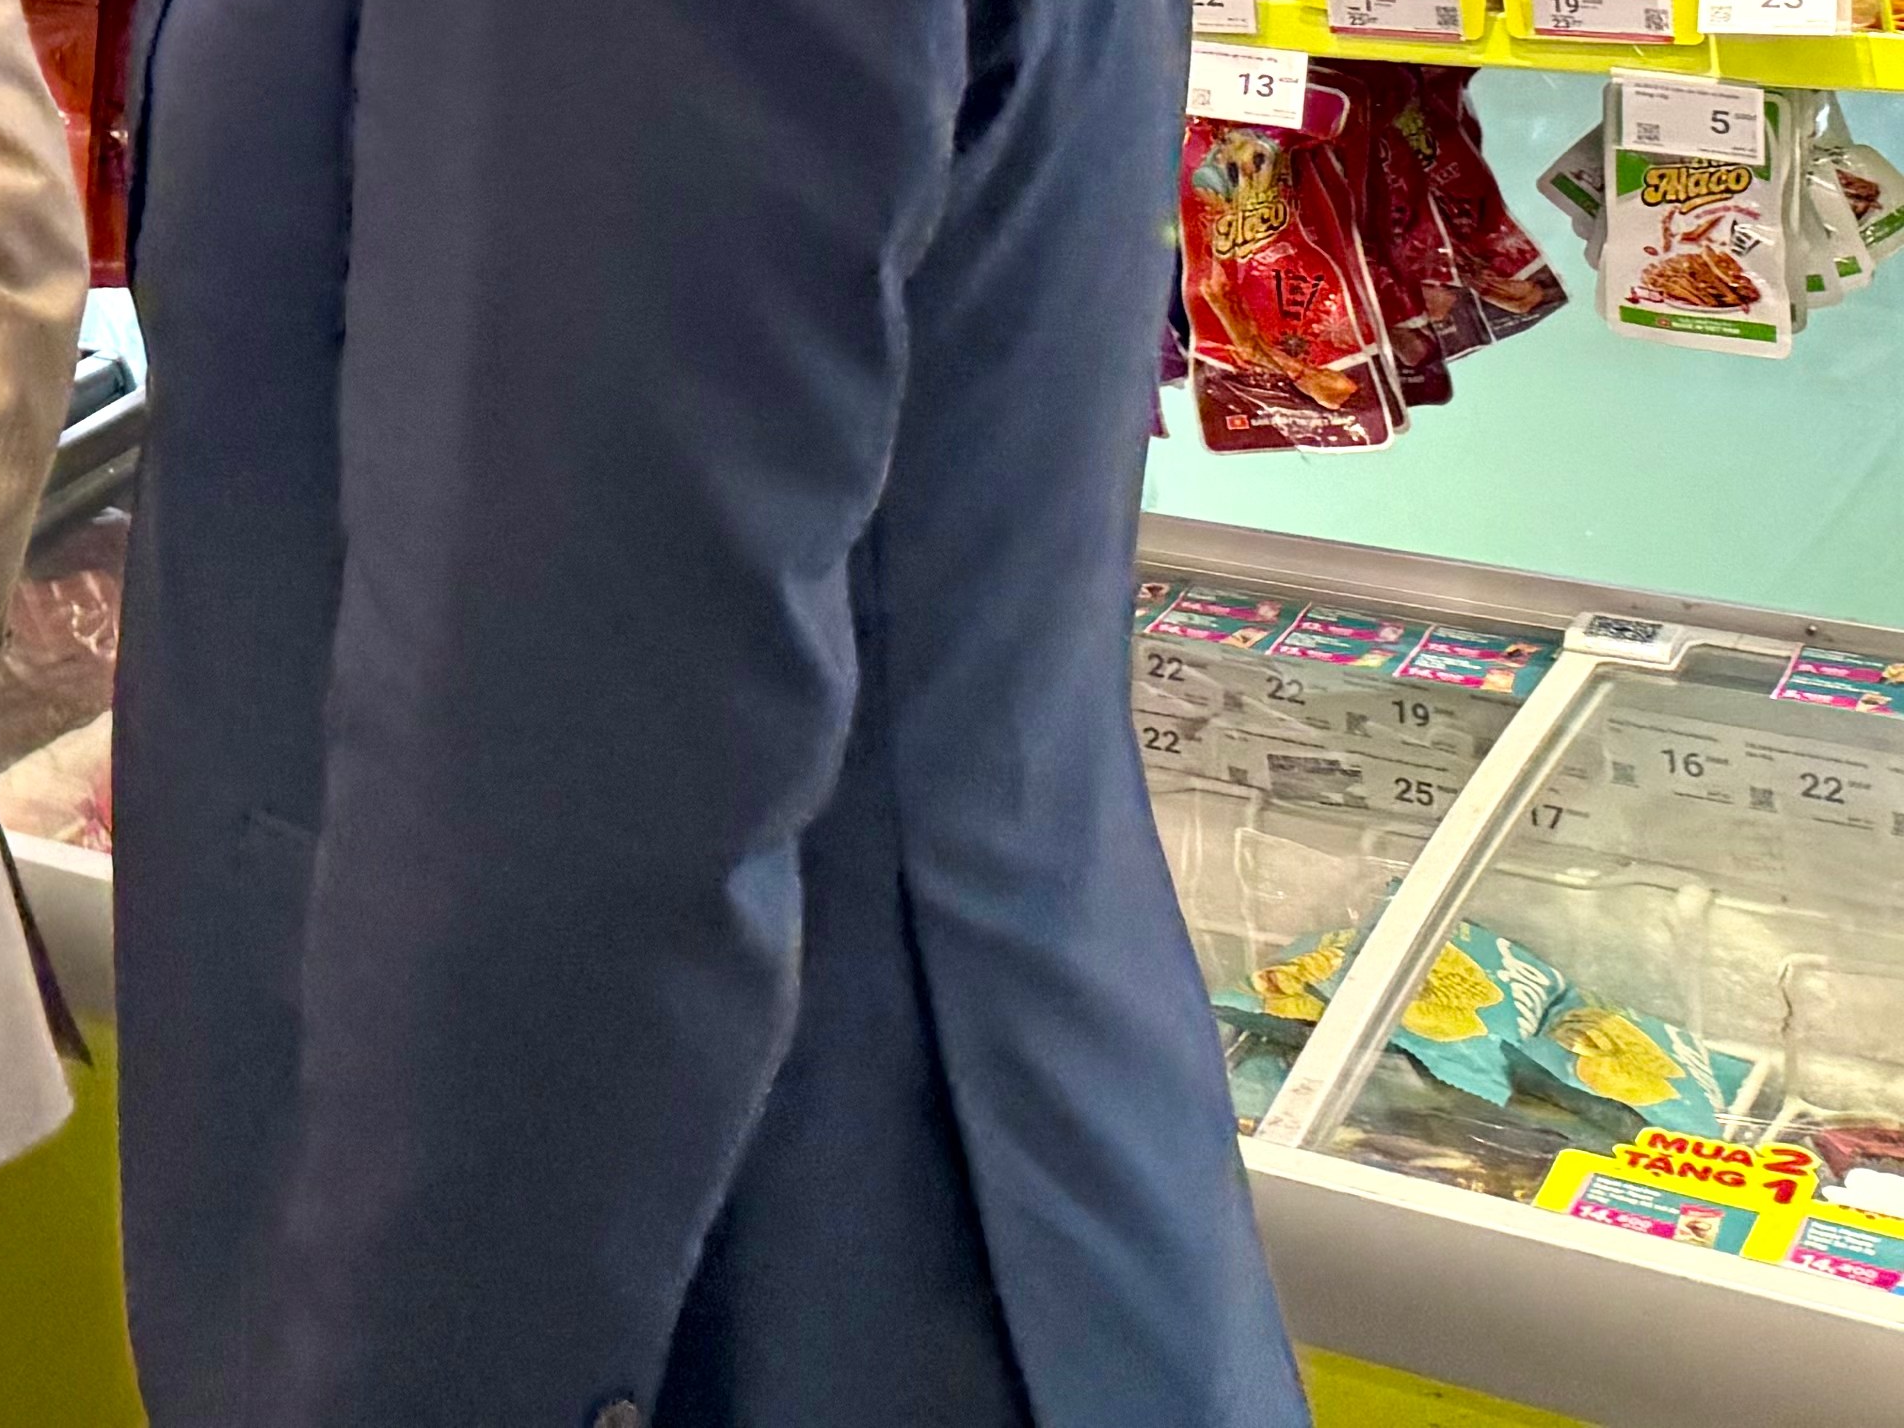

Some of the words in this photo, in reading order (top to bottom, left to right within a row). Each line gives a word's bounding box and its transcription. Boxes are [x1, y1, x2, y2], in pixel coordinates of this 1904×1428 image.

[1238, 72, 1275, 98] 13
[1710, 109, 1731, 135] 5
[1147, 654, 1186, 683] 22
[1264, 675, 1306, 706] 22
[1392, 699, 1432, 728] 19
[1142, 725, 1182, 755] 22
[1660, 748, 1706, 779] 16
[1394, 776, 1435, 807] 25
[1799, 771, 1846, 805] 22
[1646, 1132, 1755, 1168] MUA
[1762, 1147, 1814, 1177] 2
[1624, 1148, 1748, 1188] TẶNG
[1762, 1178, 1798, 1205] 1
